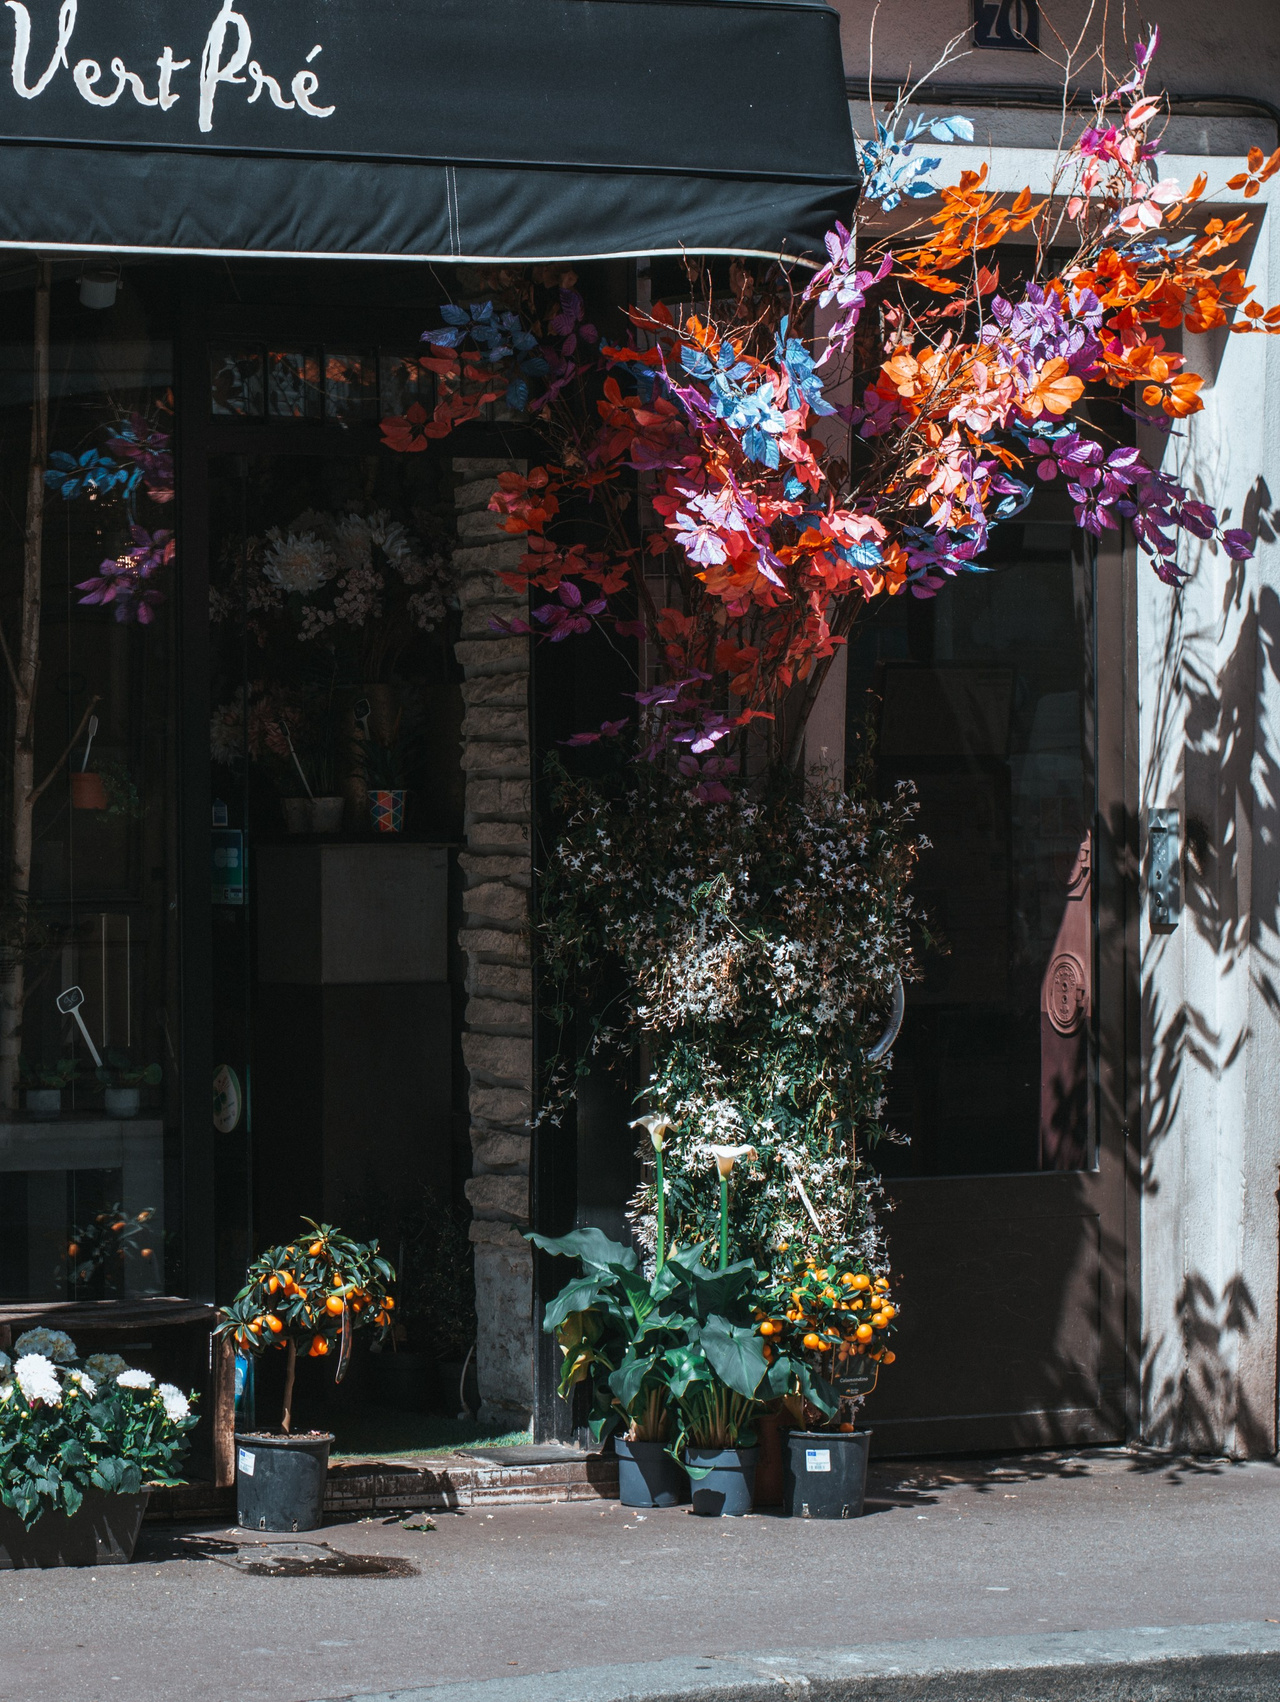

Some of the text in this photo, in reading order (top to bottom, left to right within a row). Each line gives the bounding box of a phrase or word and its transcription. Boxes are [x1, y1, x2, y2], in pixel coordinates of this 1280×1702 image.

[983, 0, 1029, 40] 70
[4, 0, 336, 132] Vert Pré
